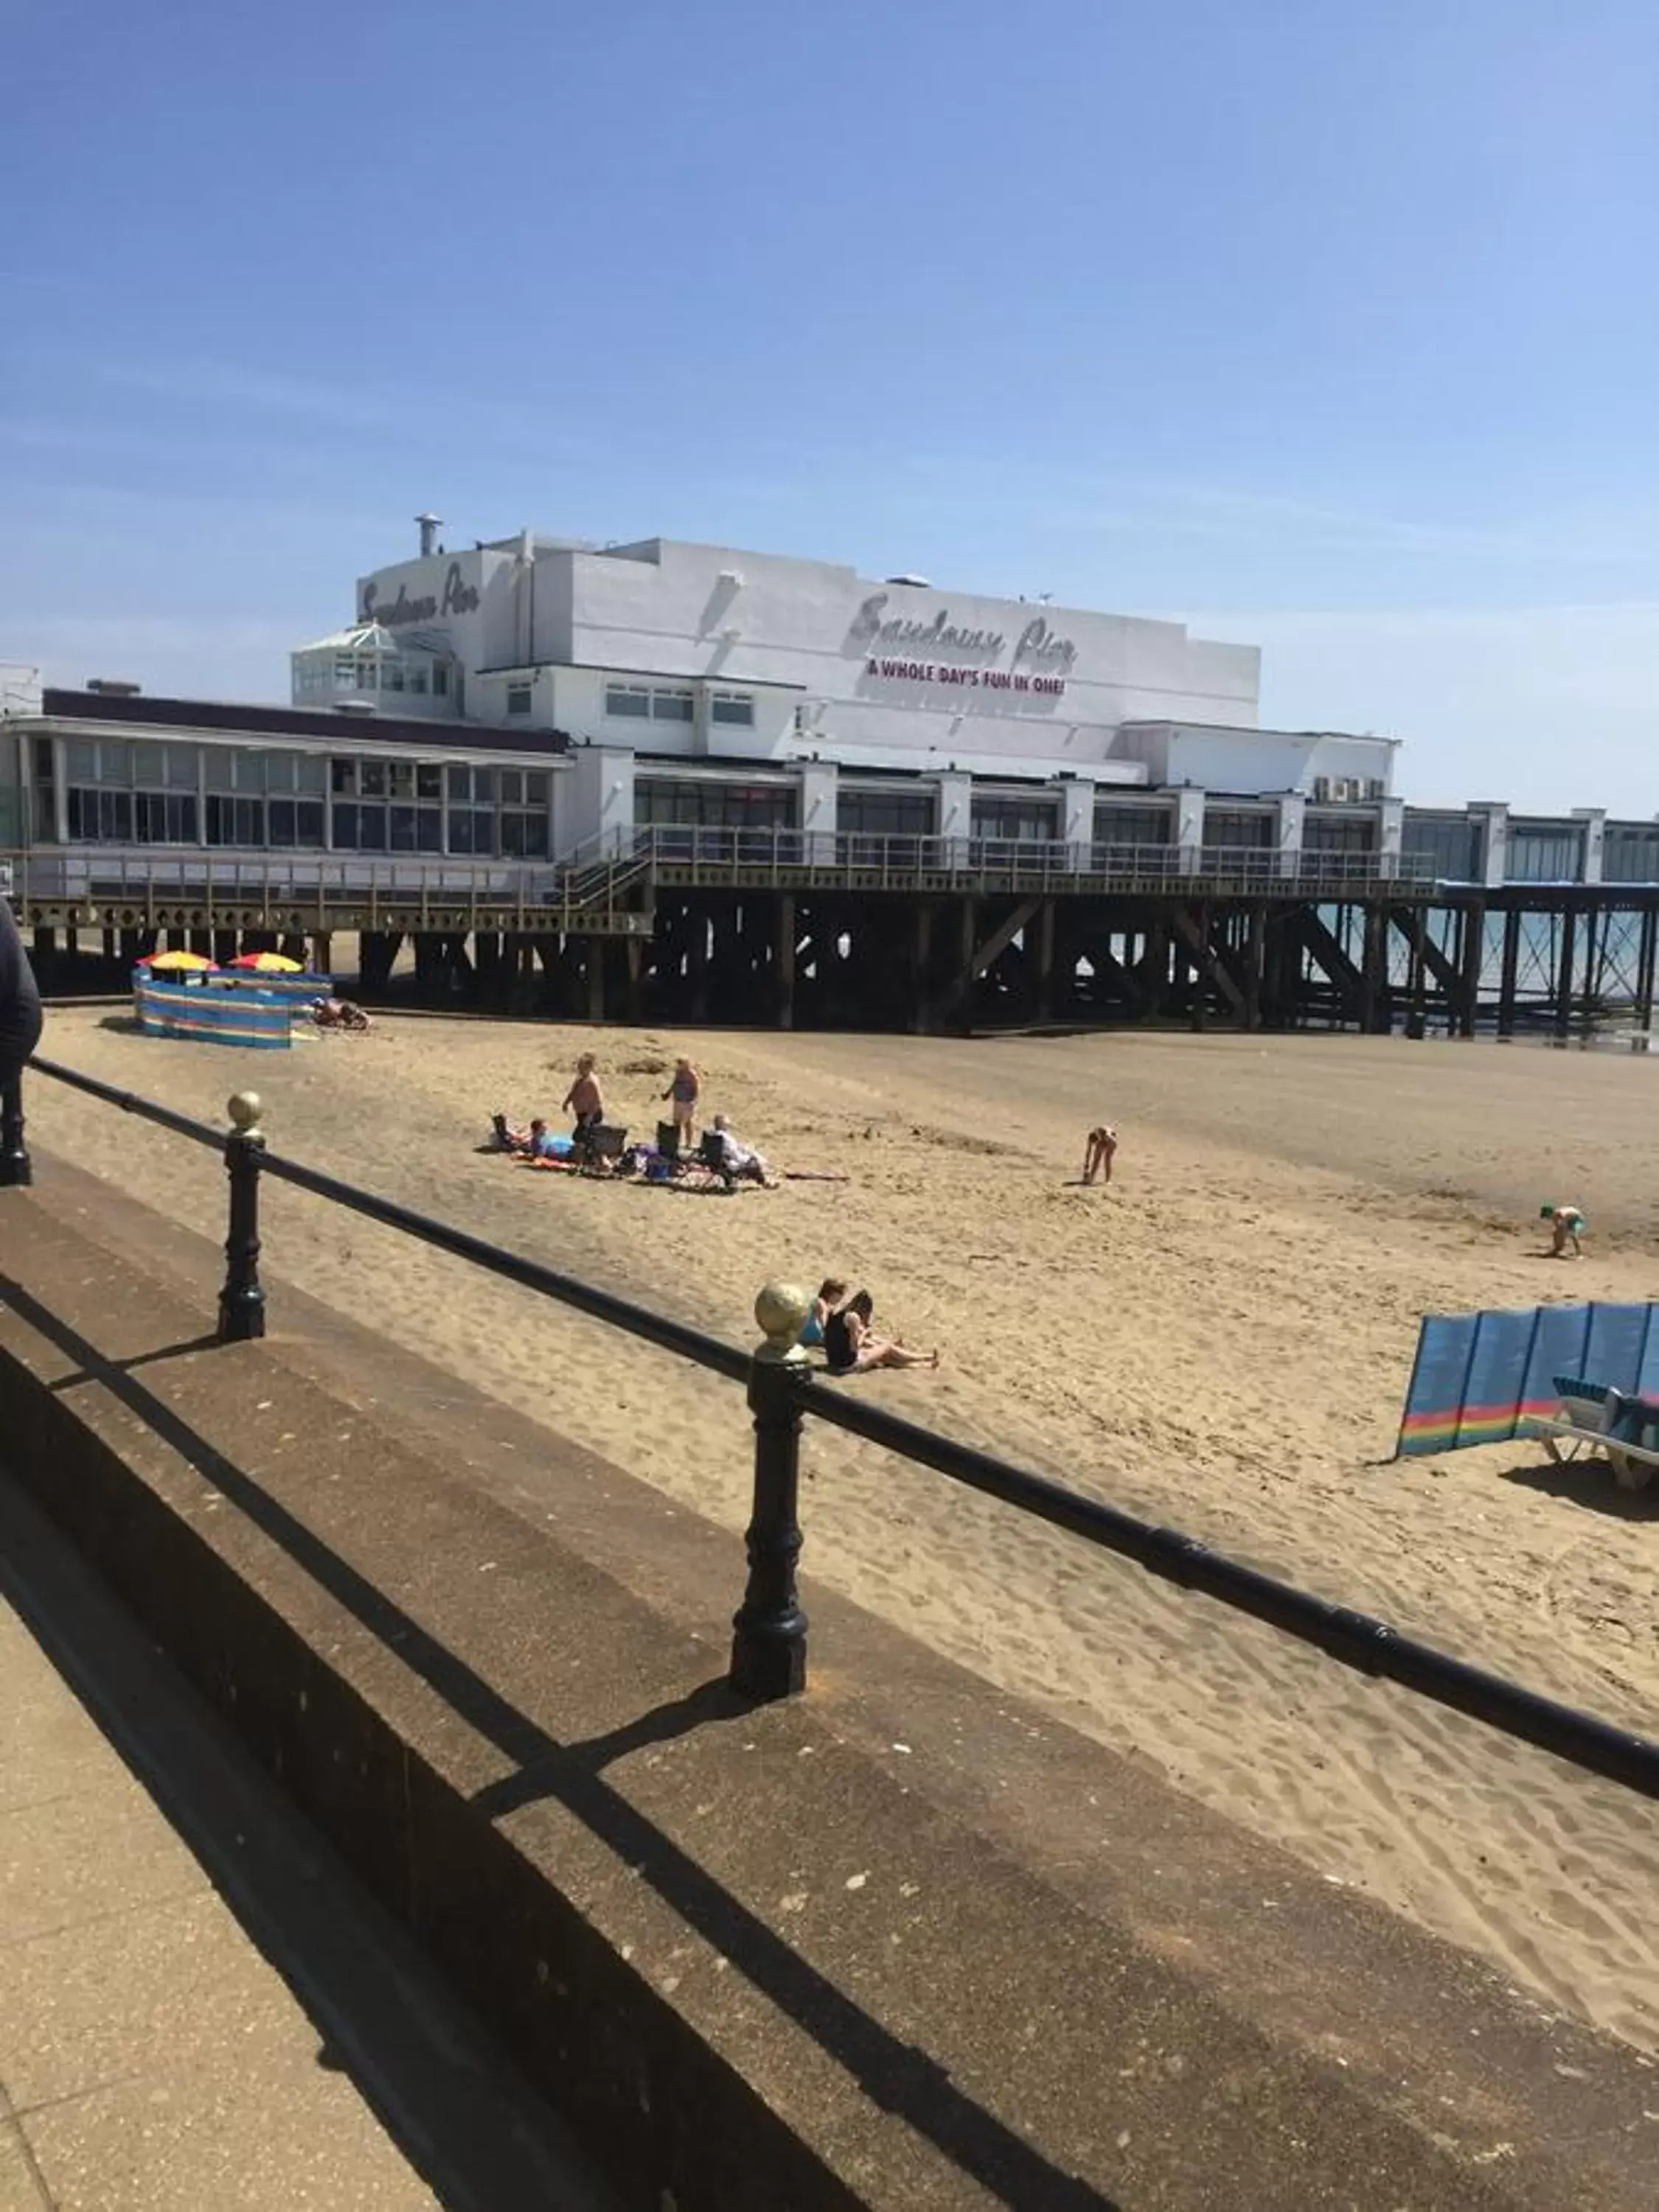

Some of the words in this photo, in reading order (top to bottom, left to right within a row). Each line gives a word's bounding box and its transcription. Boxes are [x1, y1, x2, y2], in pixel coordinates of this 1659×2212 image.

[868, 658, 878, 676] A
[881, 661, 935, 682] WHOLE
[939, 666, 979, 686] DAY'S
[984, 670, 1012, 689] FUN
[1015, 674, 1029, 692] IN
[1033, 677, 1065, 695] ONE!
